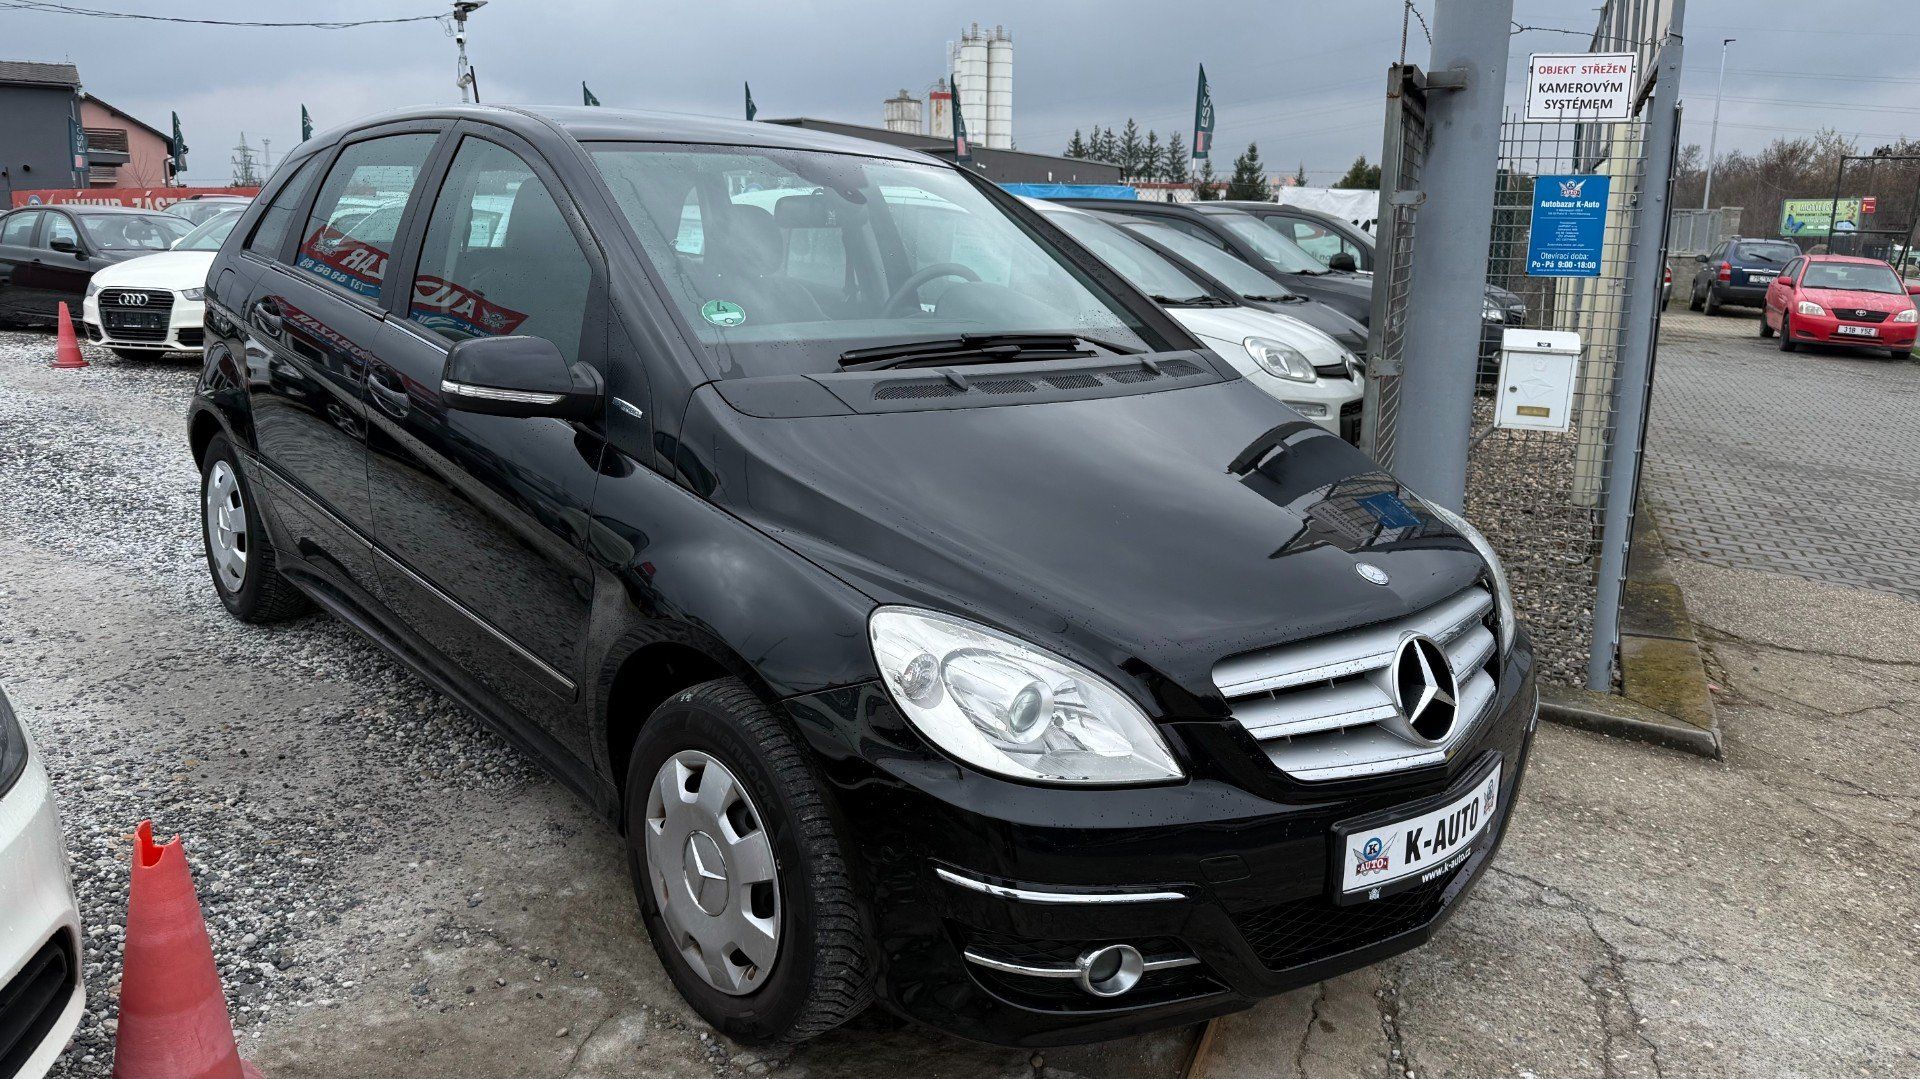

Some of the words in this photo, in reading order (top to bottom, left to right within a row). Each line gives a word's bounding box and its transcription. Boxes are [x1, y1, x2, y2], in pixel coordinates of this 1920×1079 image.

[1538, 65, 1576, 75] OBJEKT
[1581, 62, 1627, 75] STŘEŽEN
[1538, 80, 1623, 94] KAMEROVÝM
[1200, 83, 1211, 128] ESSO
[1544, 96, 1613, 110] SYSTÉMEM
[1540, 200, 1575, 208] Autobazar
[1576, 200, 1600, 208] K-Auto
[1570, 252, 1589, 260] doba:
[1404, 796, 1479, 865] K-AUTO
[1367, 842, 1378, 855] K
[1421, 847, 1472, 884] www.k-auto.cz
